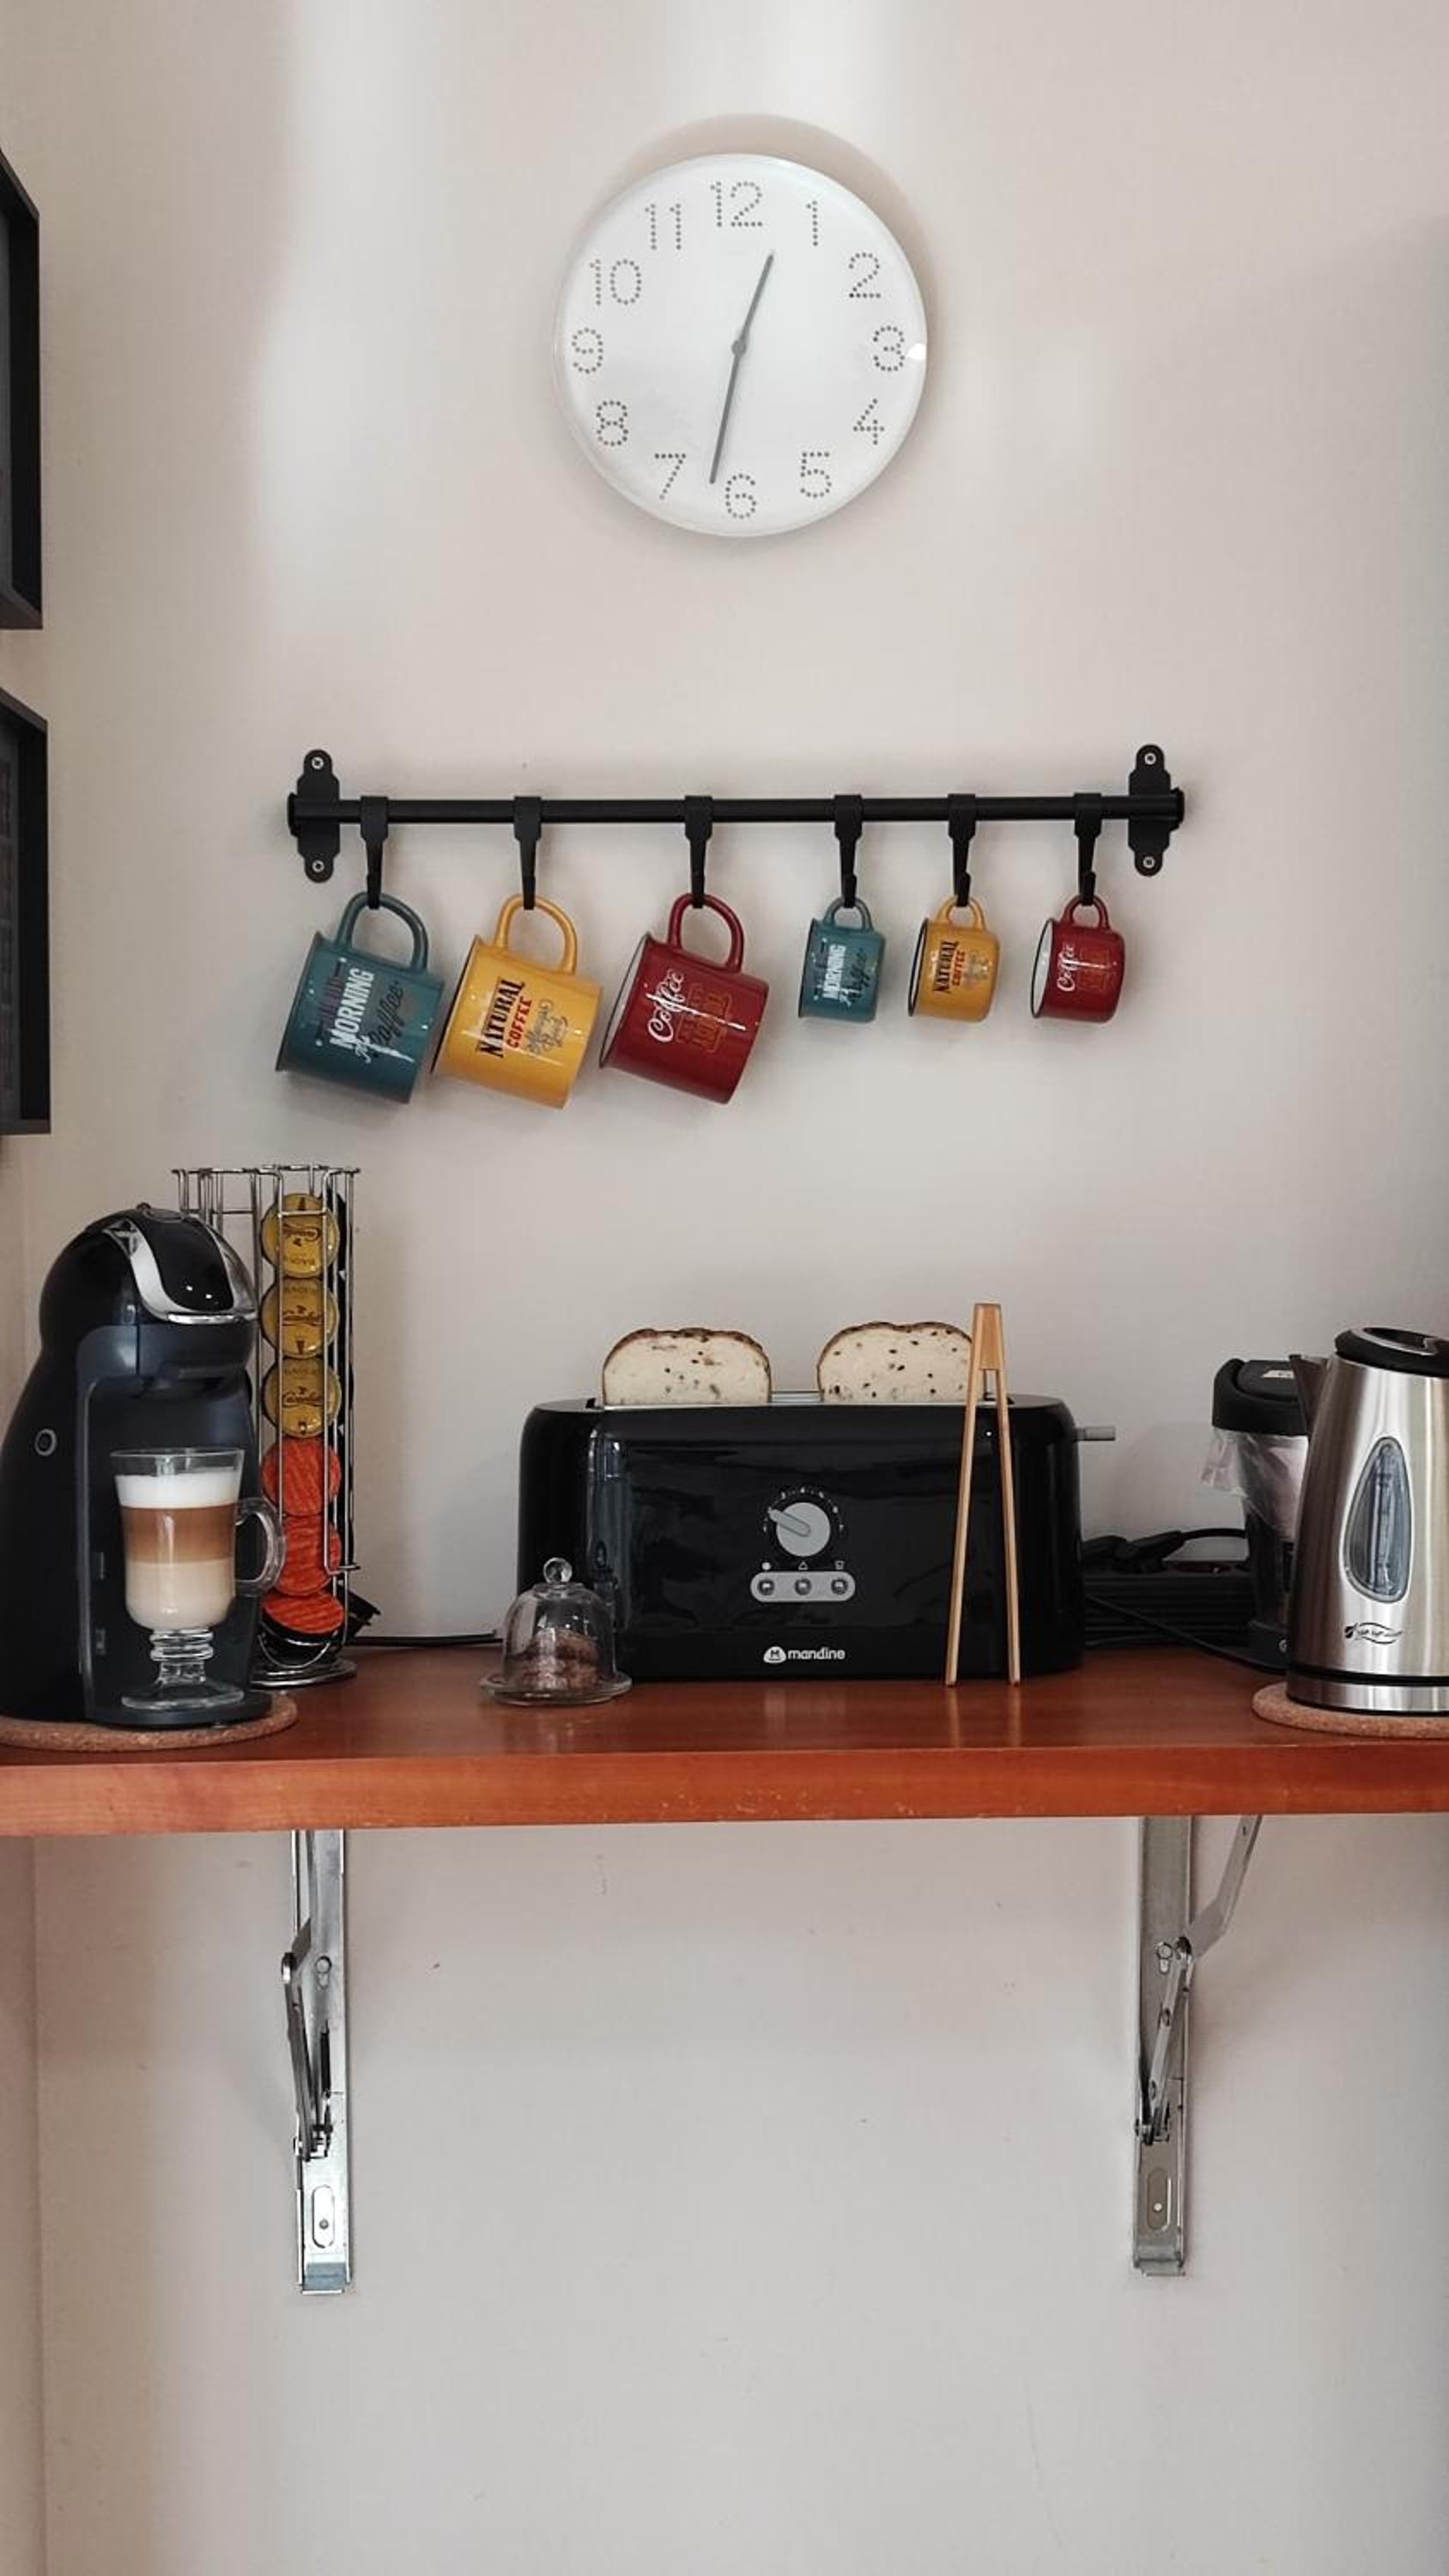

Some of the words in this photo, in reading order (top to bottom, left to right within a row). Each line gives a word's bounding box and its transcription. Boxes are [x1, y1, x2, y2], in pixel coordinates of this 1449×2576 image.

[646, 204, 682, 250] 11
[711, 181, 763, 227] 12
[806, 200, 818, 246] 1
[590, 259, 642, 305] 10
[849, 252, 882, 298] 2
[572, 327, 603, 374] 9
[873, 325, 905, 372] 3
[597, 400, 629, 447] 8
[853, 398, 885, 445] 4
[654, 453, 686, 500] 7
[725, 473, 756, 519] 6
[800, 452, 832, 498] 5
[330, 967, 375, 1049] MORNING
[506, 996, 532, 1048] COFFEE
[647, 969, 686, 1043] Coffee
[788, 1646, 846, 1660] mandine
